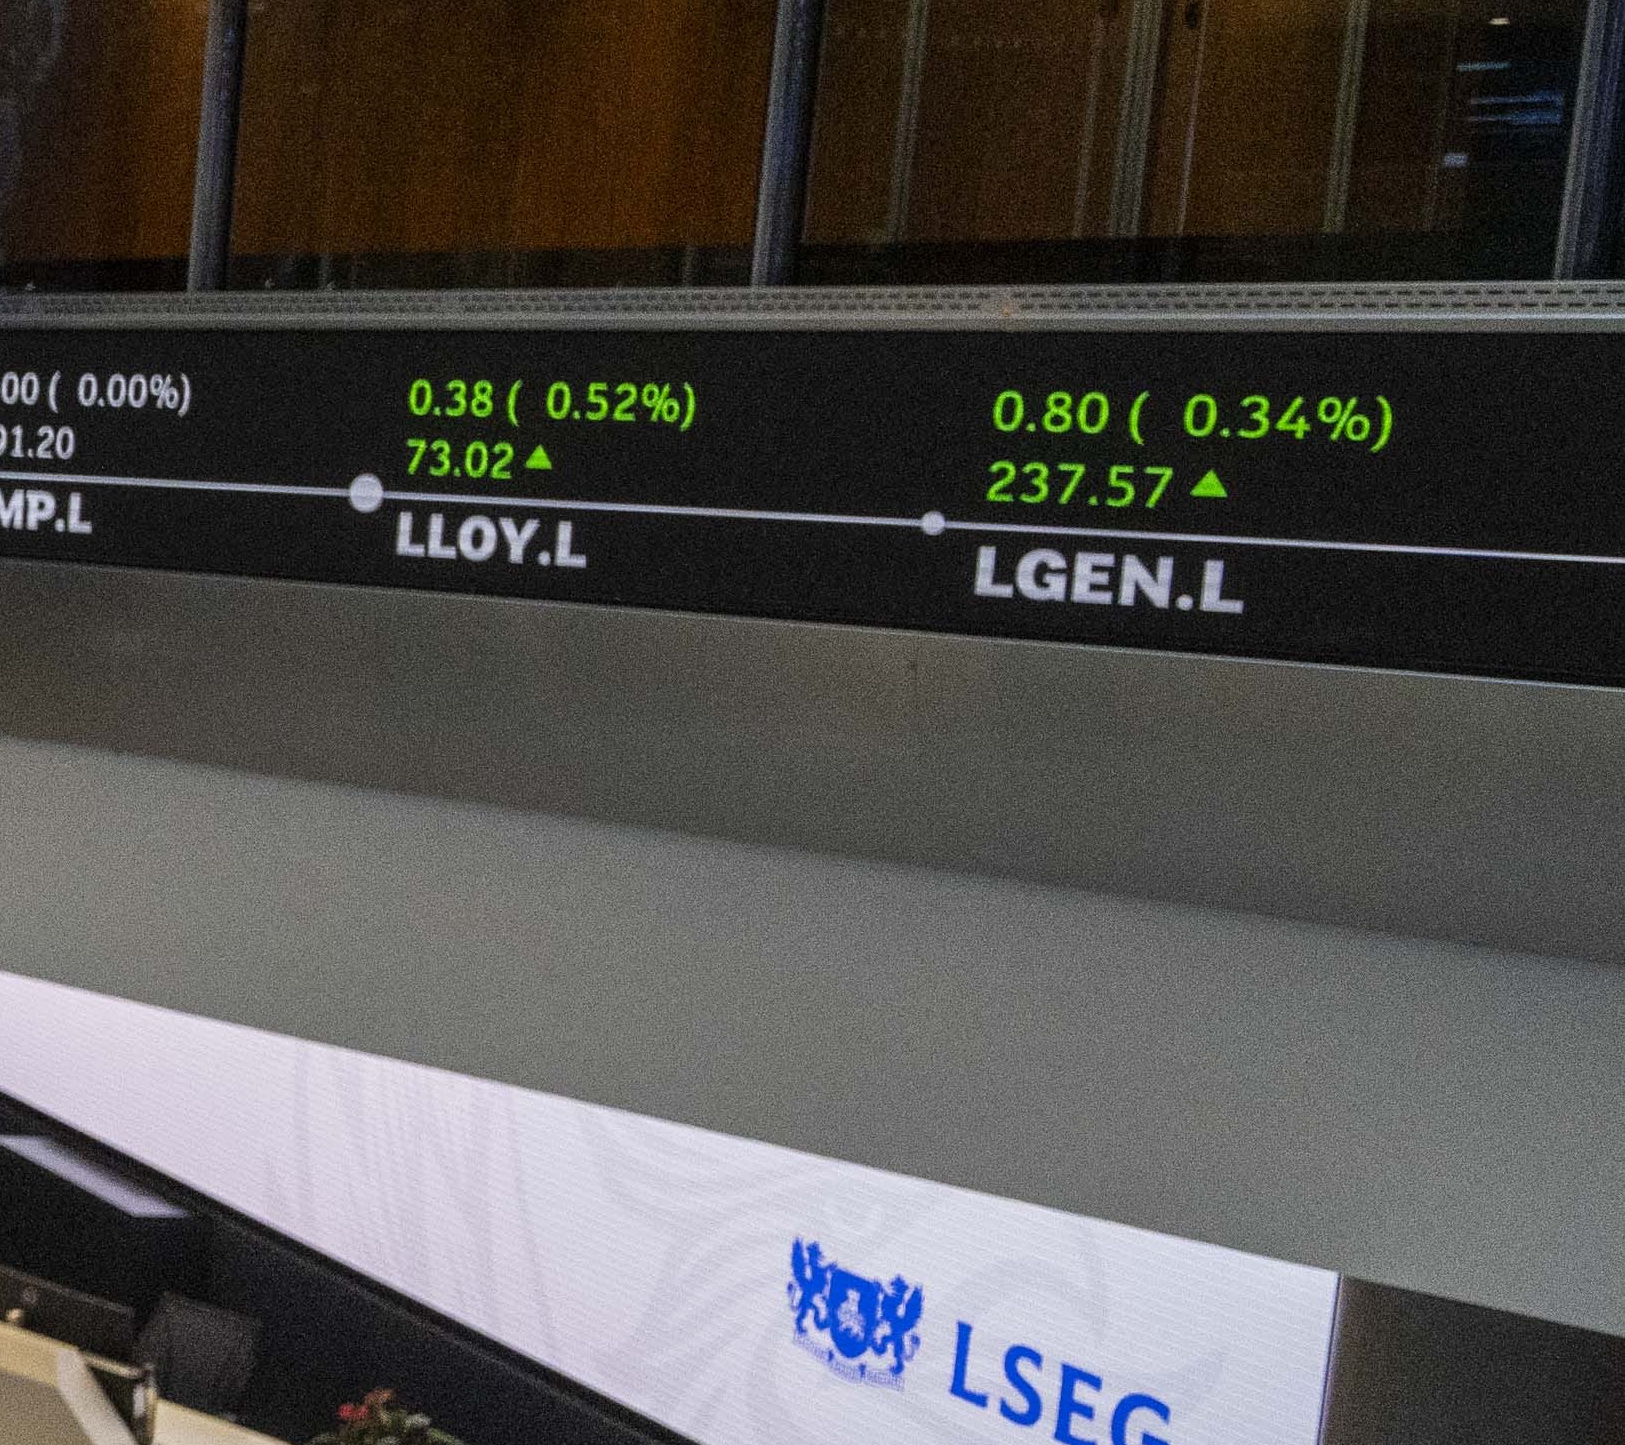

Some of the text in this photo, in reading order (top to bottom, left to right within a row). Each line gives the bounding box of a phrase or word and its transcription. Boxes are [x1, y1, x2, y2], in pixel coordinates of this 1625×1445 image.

[408, 379, 493, 417] 0.38
[992, 390, 1109, 435] 0.80
[405, 438, 514, 480] 73.02
[986, 460, 1174, 509] 237.57
[395, 512, 587, 568] LLOY.L
[973, 546, 1244, 615] LGEN.L
